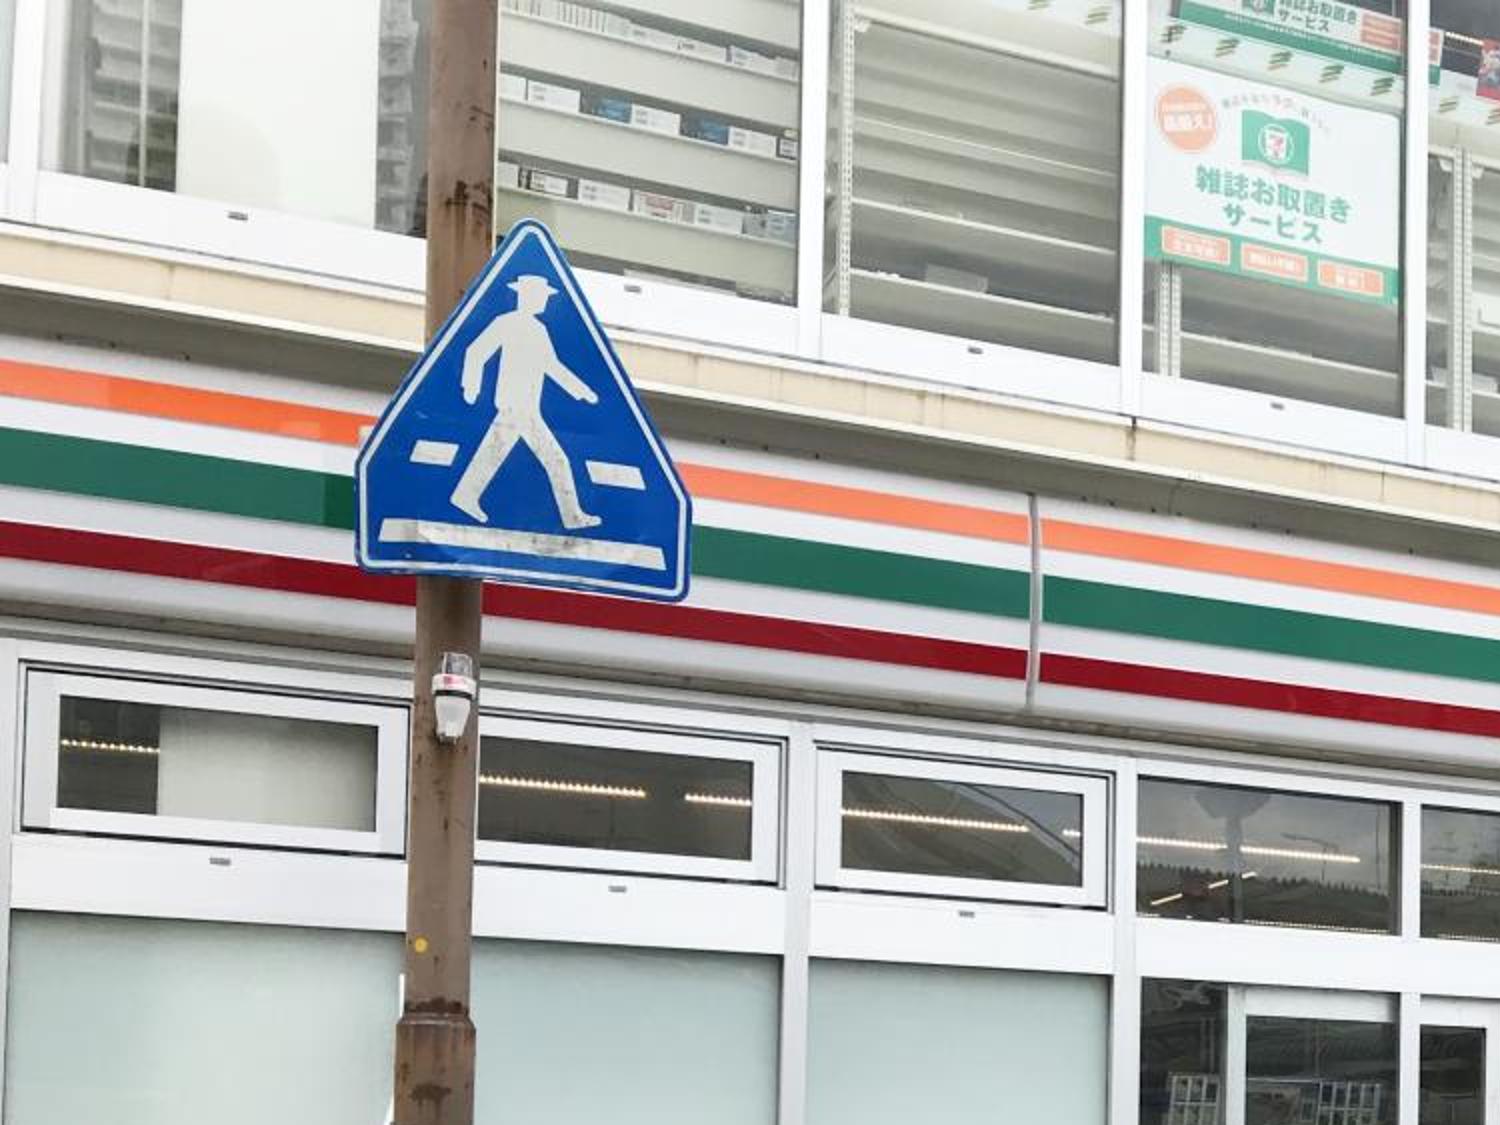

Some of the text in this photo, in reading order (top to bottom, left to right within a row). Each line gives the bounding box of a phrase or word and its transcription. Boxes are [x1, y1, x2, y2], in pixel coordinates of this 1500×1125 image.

[1196, 165, 1352, 224] 雑誌お取置き
[1223, 203, 1323, 244] サービス
